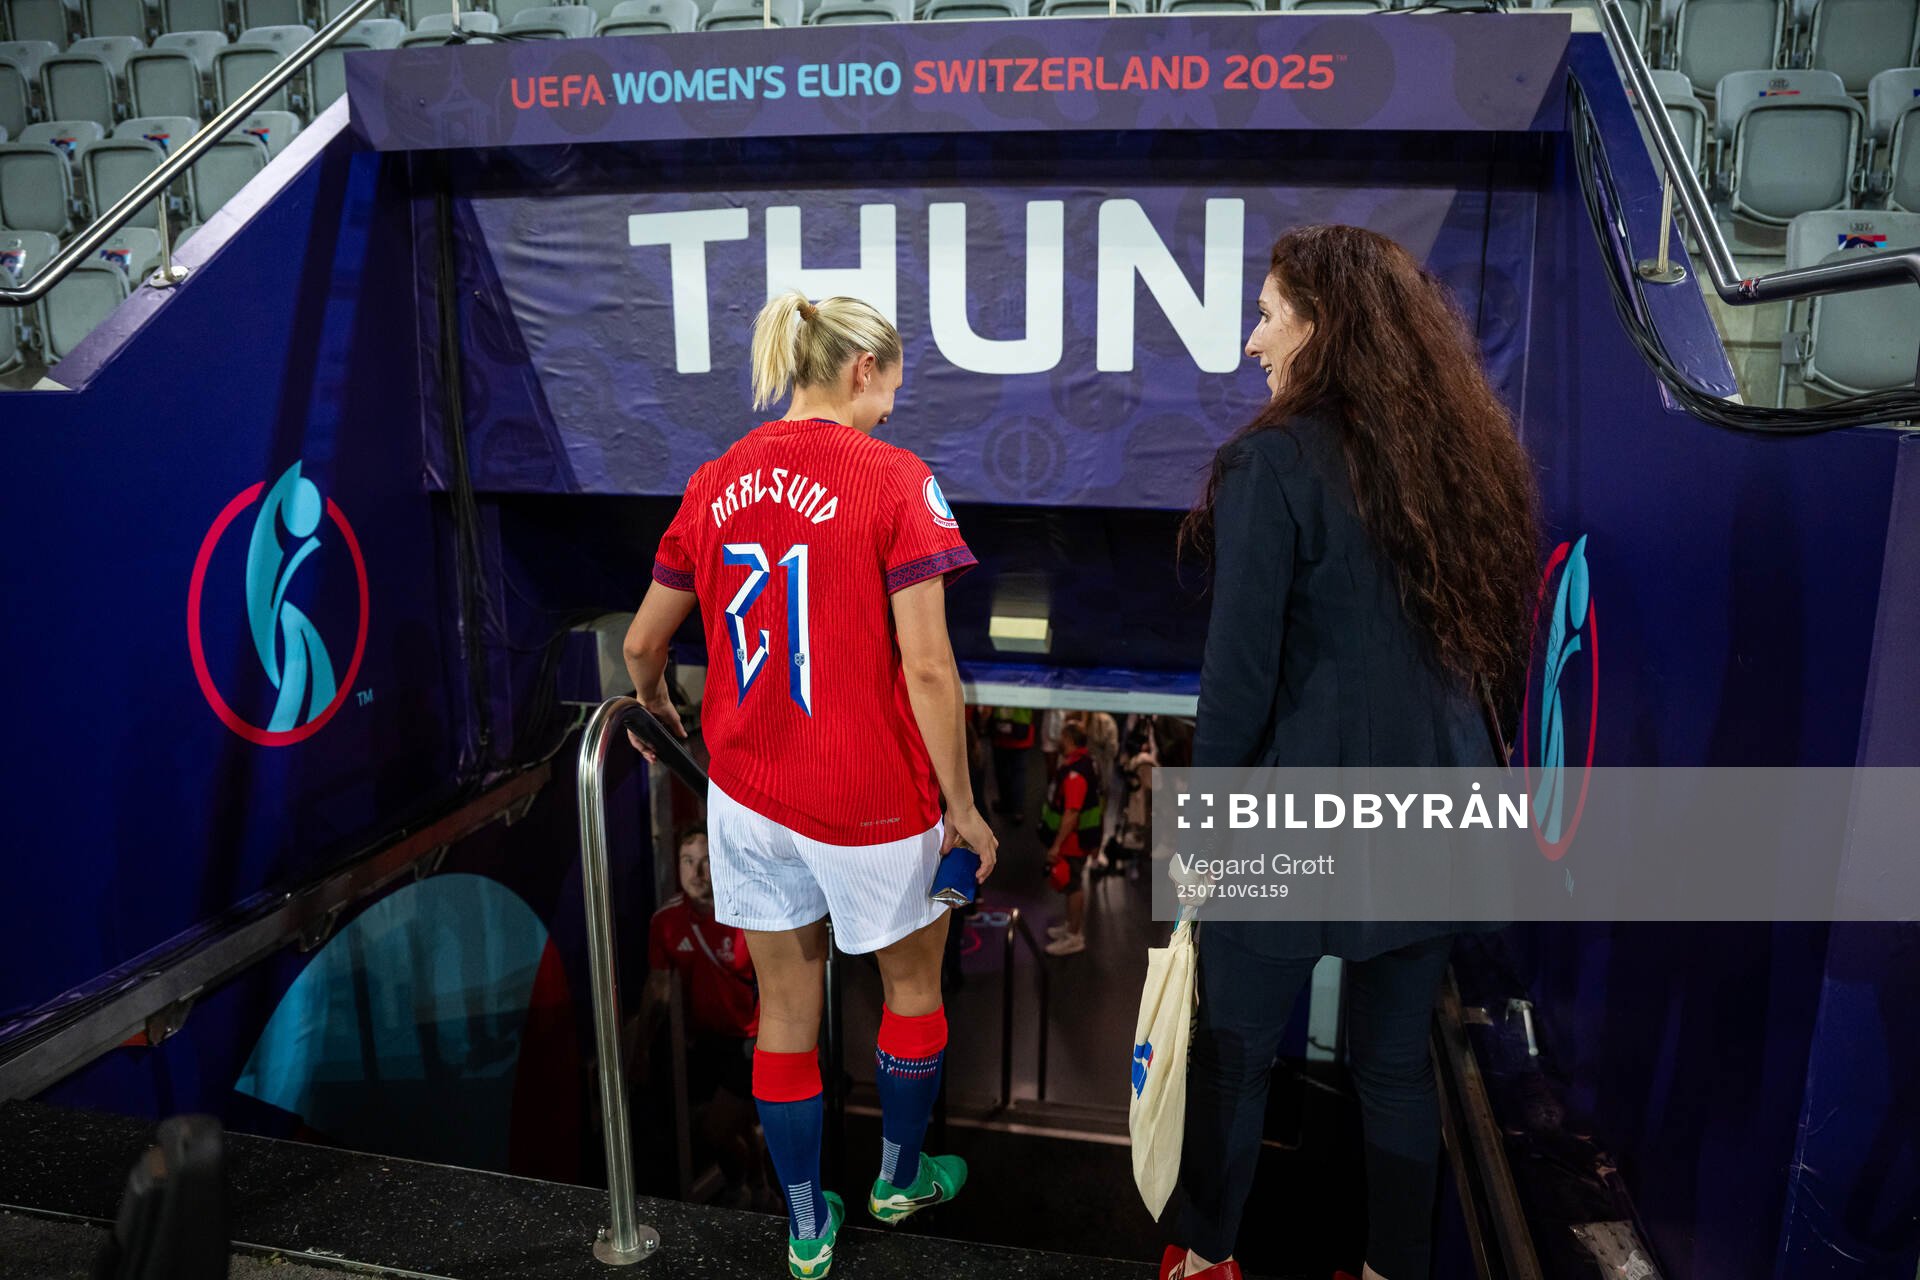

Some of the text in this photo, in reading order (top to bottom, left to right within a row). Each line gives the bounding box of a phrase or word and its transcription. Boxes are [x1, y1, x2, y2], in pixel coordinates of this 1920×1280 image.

[511, 74, 606, 109] UEFA
[612, 66, 785, 104] WOMEN'S
[797, 62, 901, 97] EURO
[913, 55, 1210, 94] SWITZERLAND
[628, 198, 1245, 374] THUN
[722, 543, 812, 718] 21
